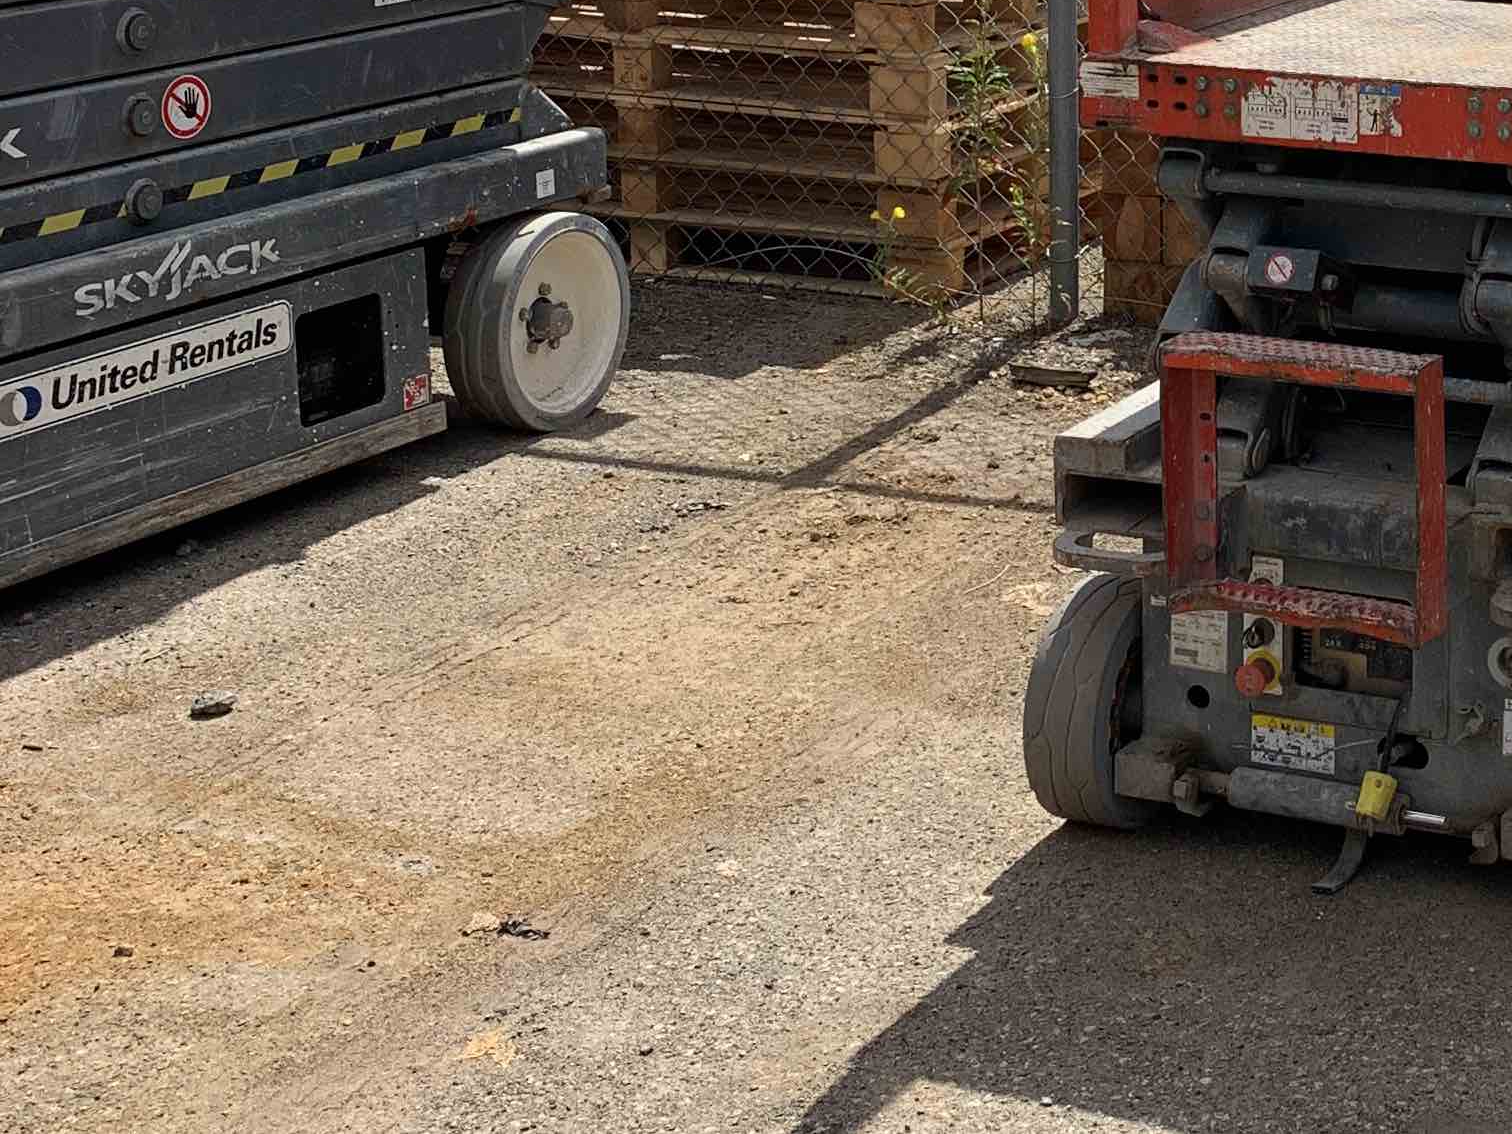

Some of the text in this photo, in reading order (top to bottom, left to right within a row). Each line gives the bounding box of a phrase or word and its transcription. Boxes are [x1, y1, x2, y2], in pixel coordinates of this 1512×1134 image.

[74, 239, 281, 317] SKYJACK
[51, 318, 278, 410] United Rentals
